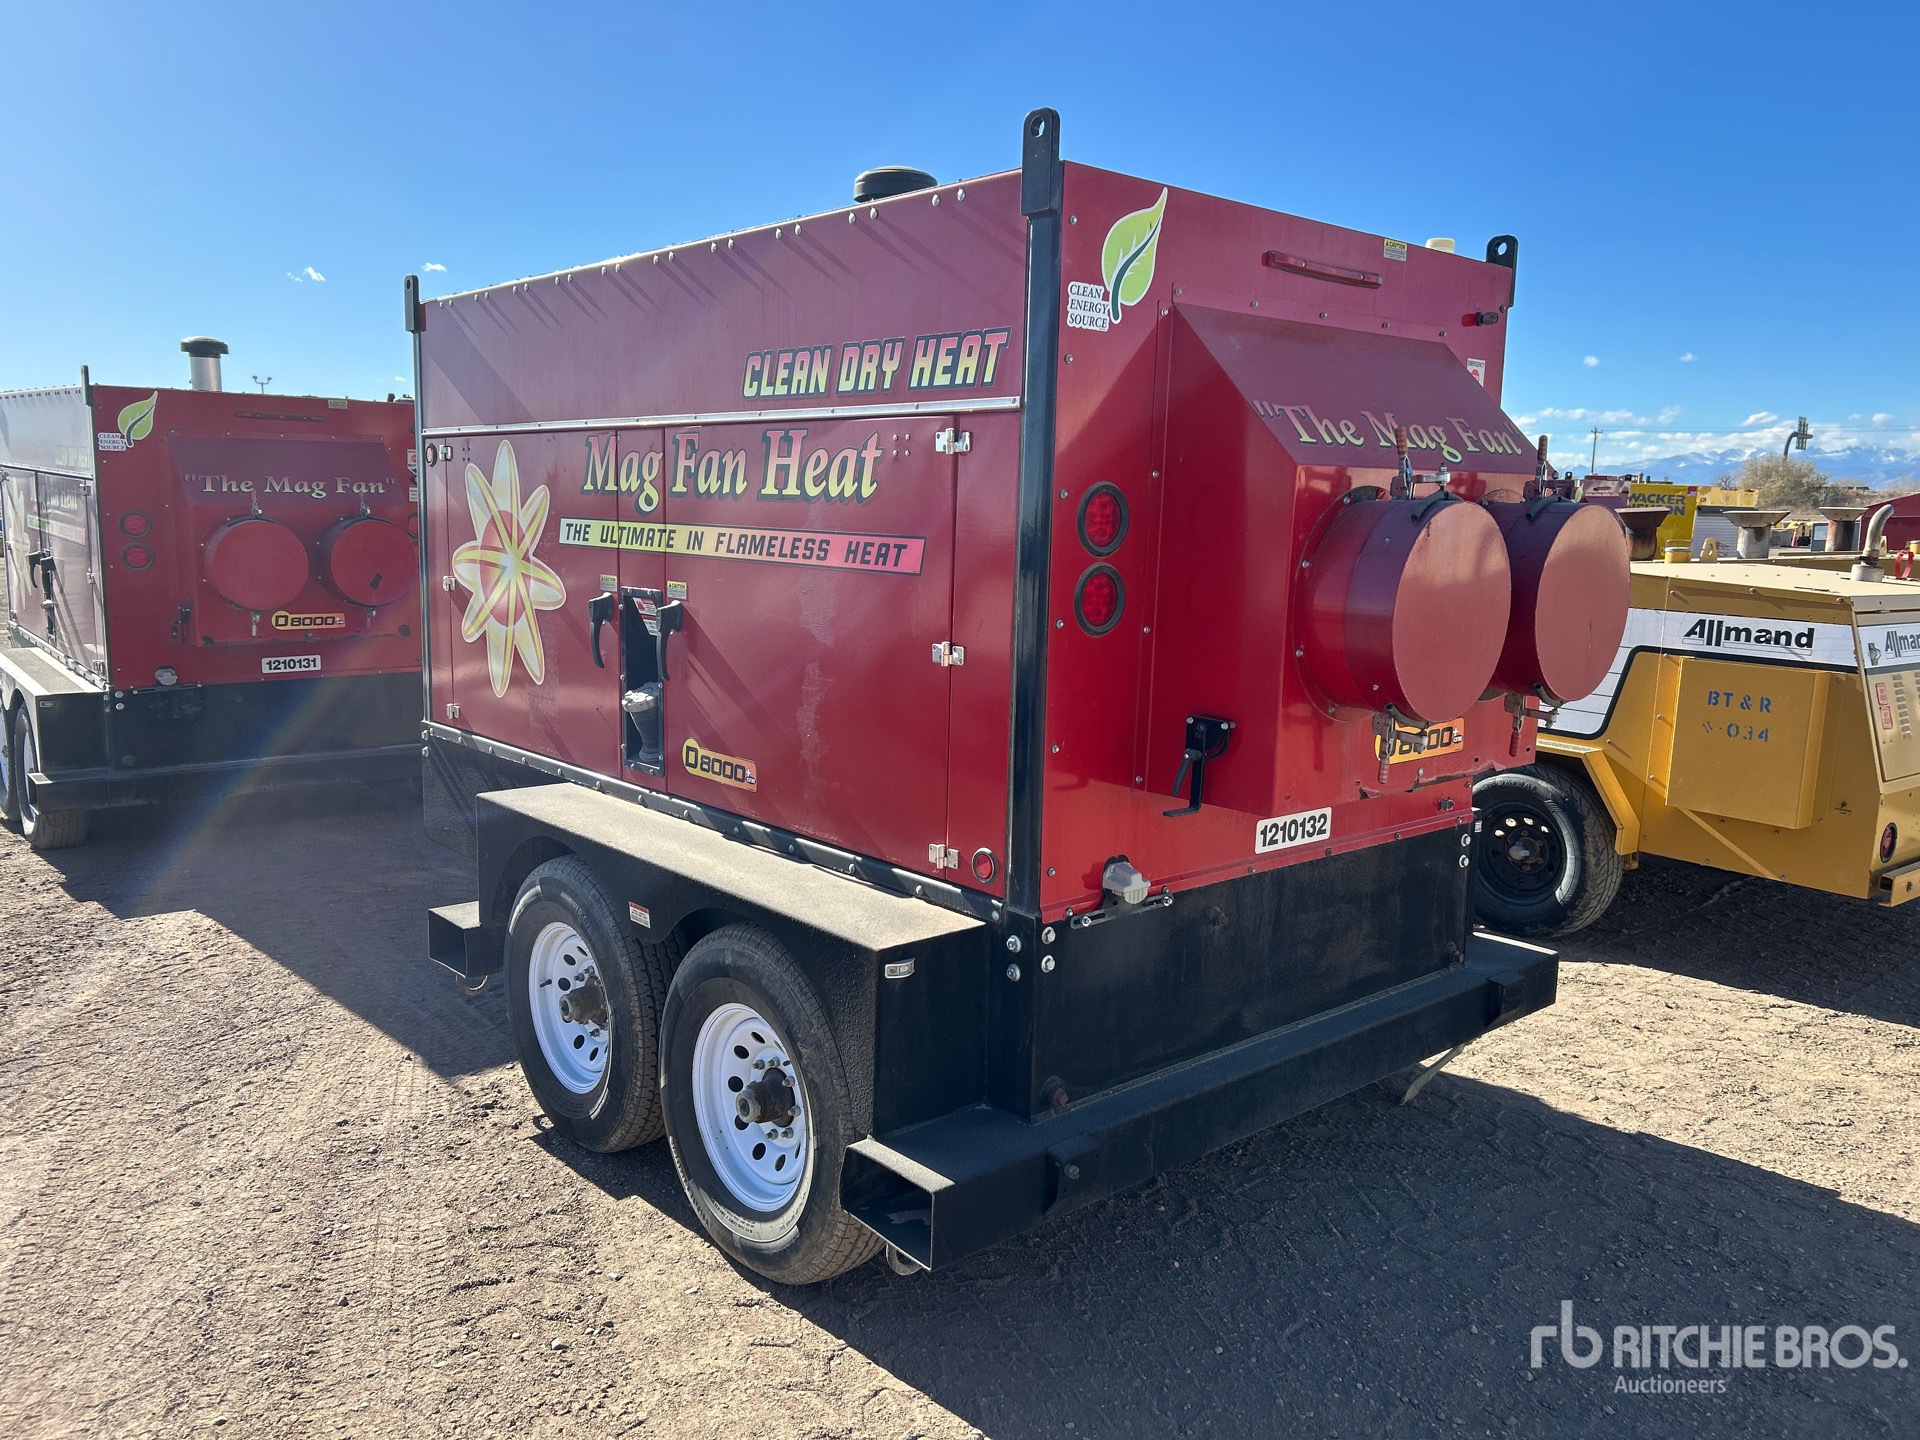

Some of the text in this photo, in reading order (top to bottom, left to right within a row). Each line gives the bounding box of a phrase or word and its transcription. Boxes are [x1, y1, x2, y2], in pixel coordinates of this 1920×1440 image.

[1070, 284, 1102, 299] CLEAN
[1070, 299, 1109, 314] ENERGY
[1069, 313, 1108, 329] SOURCE
[742, 327, 1012, 399] CLEAN DRY HEAT
[1361, 410, 1462, 464] Mag
[581, 429, 883, 514] Mag Fan Heat
[264, 476, 327, 499] Mag
[1628, 493, 1686, 505] WACKER
[565, 522, 908, 568] THE ULTIMATE IN FLAMELESS HEAT
[1683, 618, 1816, 649] Allmand
[266, 657, 317, 671] 1210131
[1759, 696, 1772, 713] R
[1260, 813, 1328, 847] 1210132
